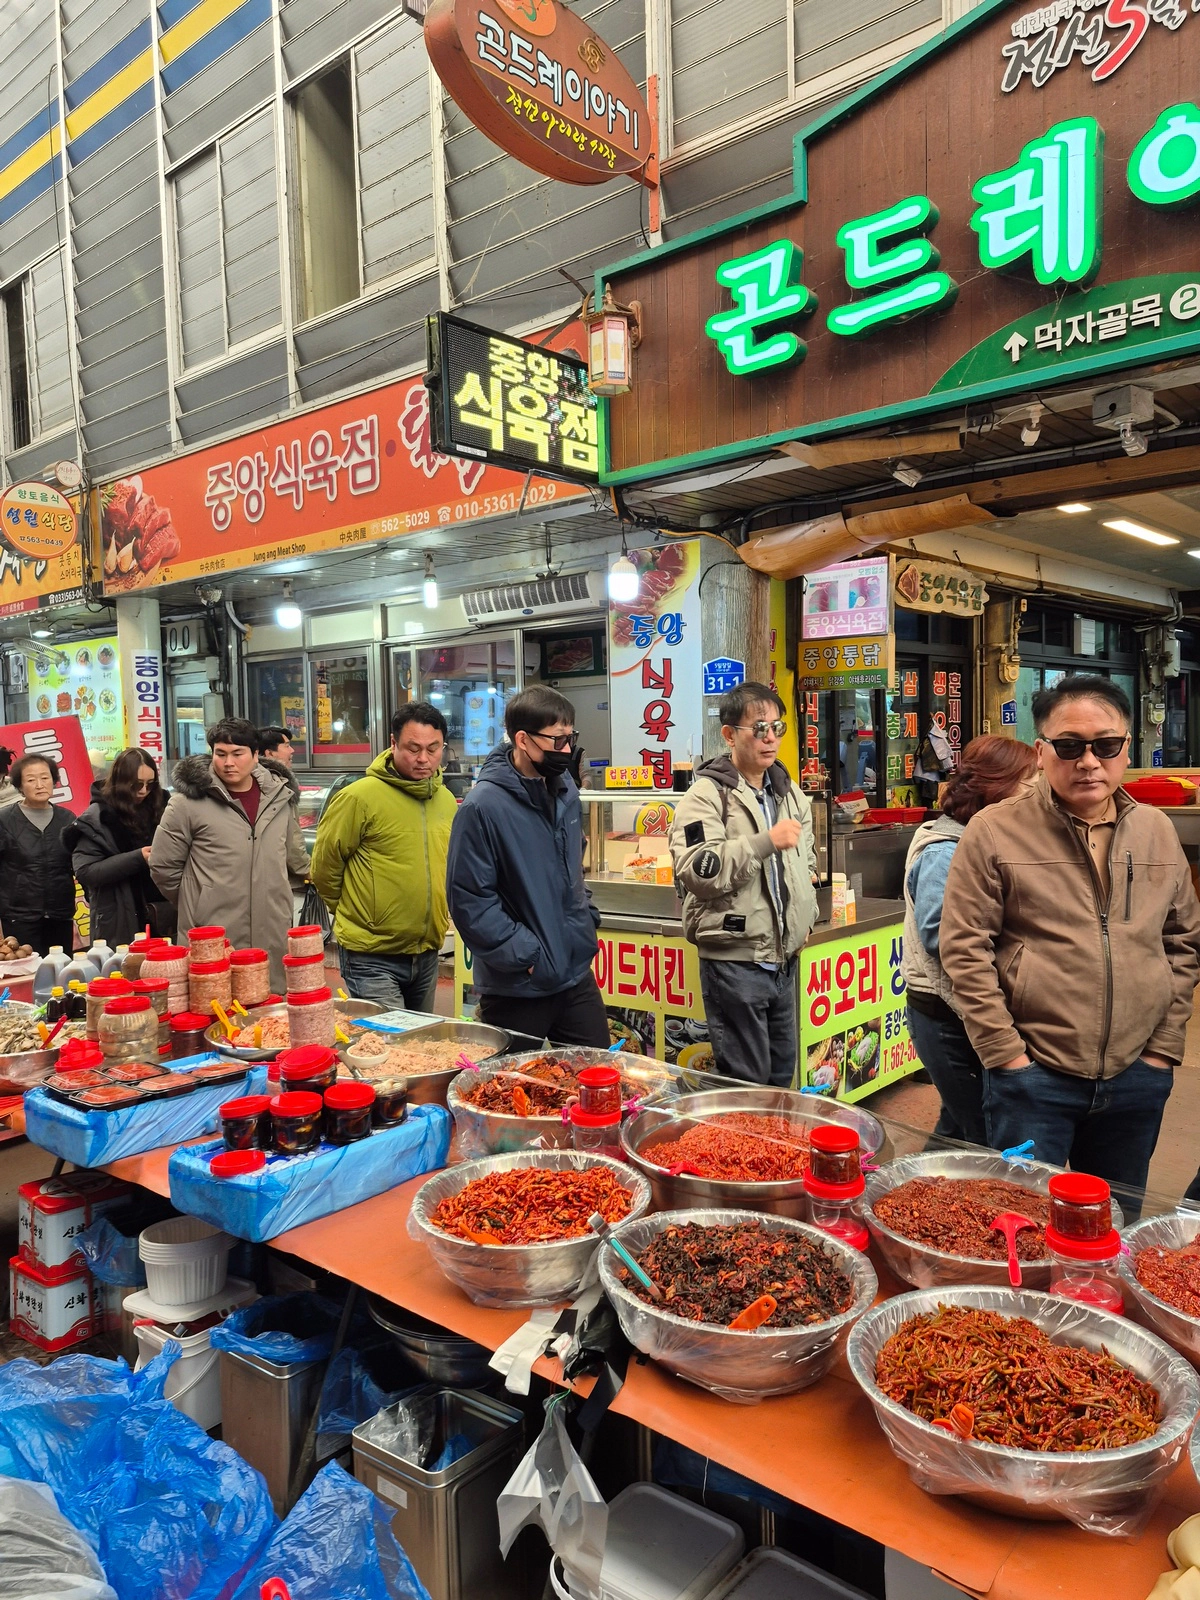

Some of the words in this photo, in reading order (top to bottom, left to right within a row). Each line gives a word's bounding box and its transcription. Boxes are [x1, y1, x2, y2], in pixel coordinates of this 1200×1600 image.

[476, 10, 639, 150] 곤드레이야기
[506, 86, 538, 123] 정선
[541, 110, 588, 151] 아리랑
[1034, 293, 1164, 352] 먹자골목
[488, 336, 563, 395] 중앙
[454, 371, 598, 473] 식육점
[204, 413, 381, 531] 중앙식육점
[17, 488, 61, 504] 향토음식
[381, 510, 430, 533] 562-5029
[26, 537, 64, 547] 563-0439
[253, 551, 266, 562] Jung
[266, 550, 277, 560] ang
[277, 545, 292, 556] Meat
[292, 543, 306, 555] Shop
[920, 571, 983, 611] 중앙식육점
[628, 612, 687, 648] 중앙
[806, 612, 884, 637] 중앙식육점
[803, 642, 881, 670] 중앙통닭
[707, 675, 740, 691] 31-1
[639, 657, 676, 789] 식육점
[609, 768, 649, 780] 컵닭강정
[806, 944, 884, 1027] 생오리,
[889, 936, 907, 996] 생
[883, 1049, 889, 1074] T.
[64, 1292, 87, 1309] 신화
